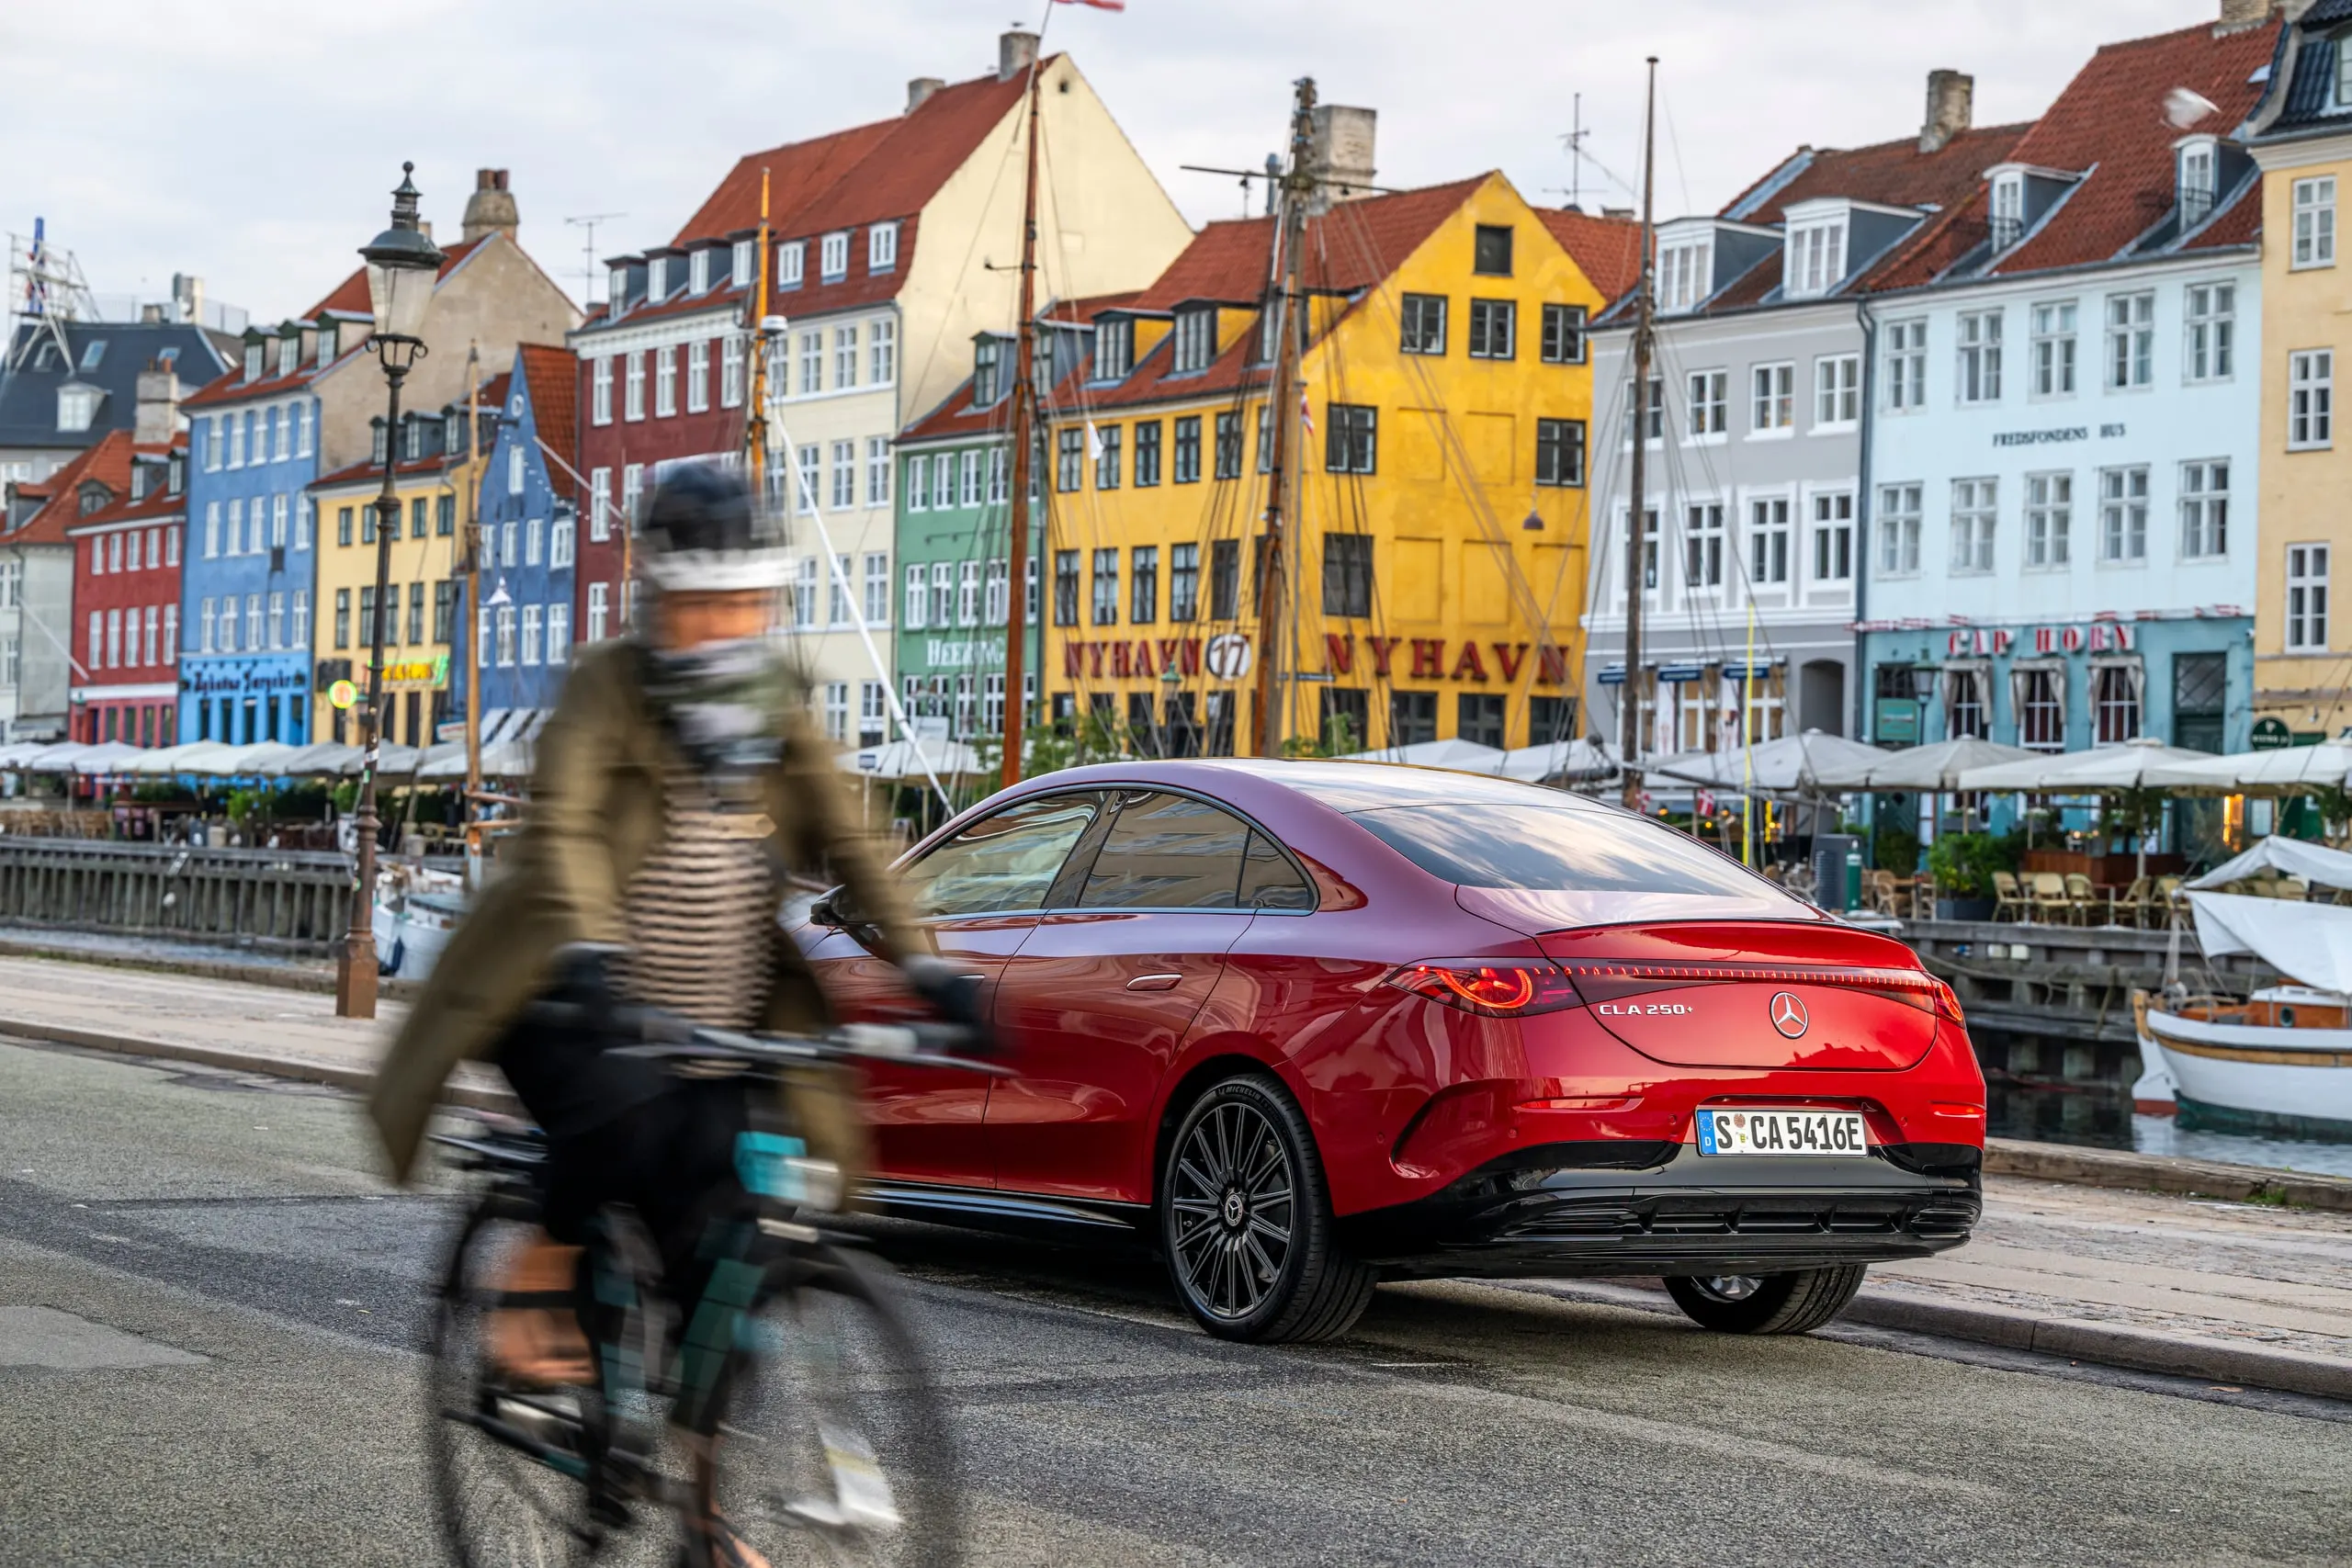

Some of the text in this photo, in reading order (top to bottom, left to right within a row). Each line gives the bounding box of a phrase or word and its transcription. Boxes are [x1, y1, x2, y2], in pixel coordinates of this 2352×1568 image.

[1949, 625, 2135, 655] CAP HORN
[1064, 637, 1202, 678] NYHAVN
[1214, 641, 1245, 677] 17
[1322, 633, 1569, 684] NYHAVN
[1599, 1004, 1694, 1015] CLA 250+
[1226, 1085, 1261, 1102] MICHELIN
[1704, 1136, 1712, 1146] D
[1715, 1115, 1863, 1151] S CA 5416E
